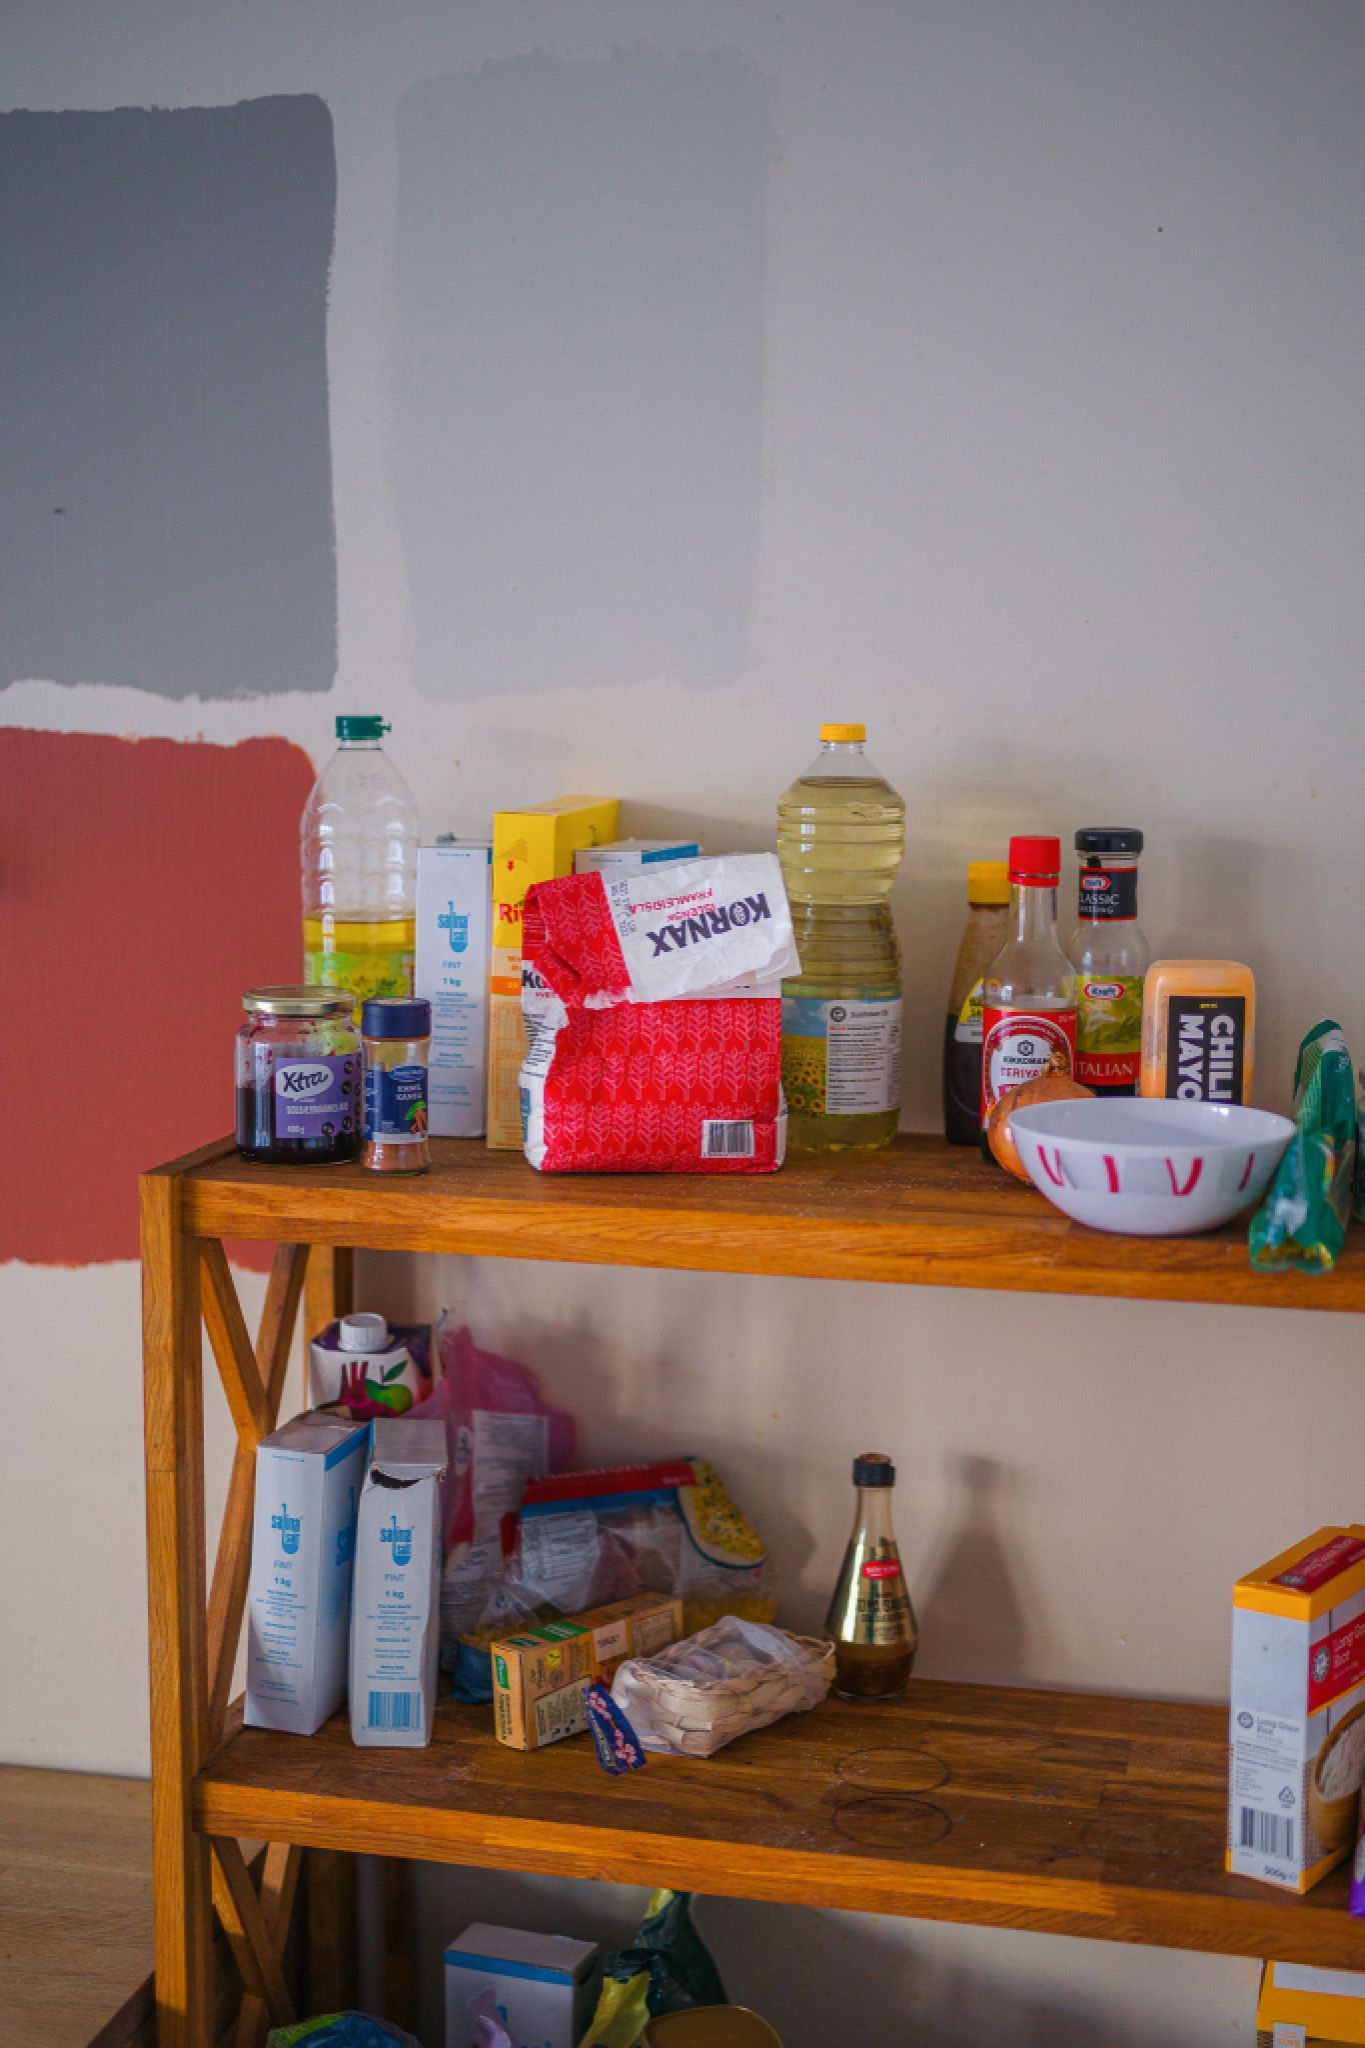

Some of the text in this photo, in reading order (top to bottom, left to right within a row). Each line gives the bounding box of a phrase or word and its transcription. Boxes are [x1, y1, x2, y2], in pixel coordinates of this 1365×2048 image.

[645, 892, 772, 958] KORNAX
[1074, 1061, 1134, 1077] ITALIAN
[1177, 1013, 1205, 1100] MAYO
[1209, 1014, 1235, 1099] CHILI
